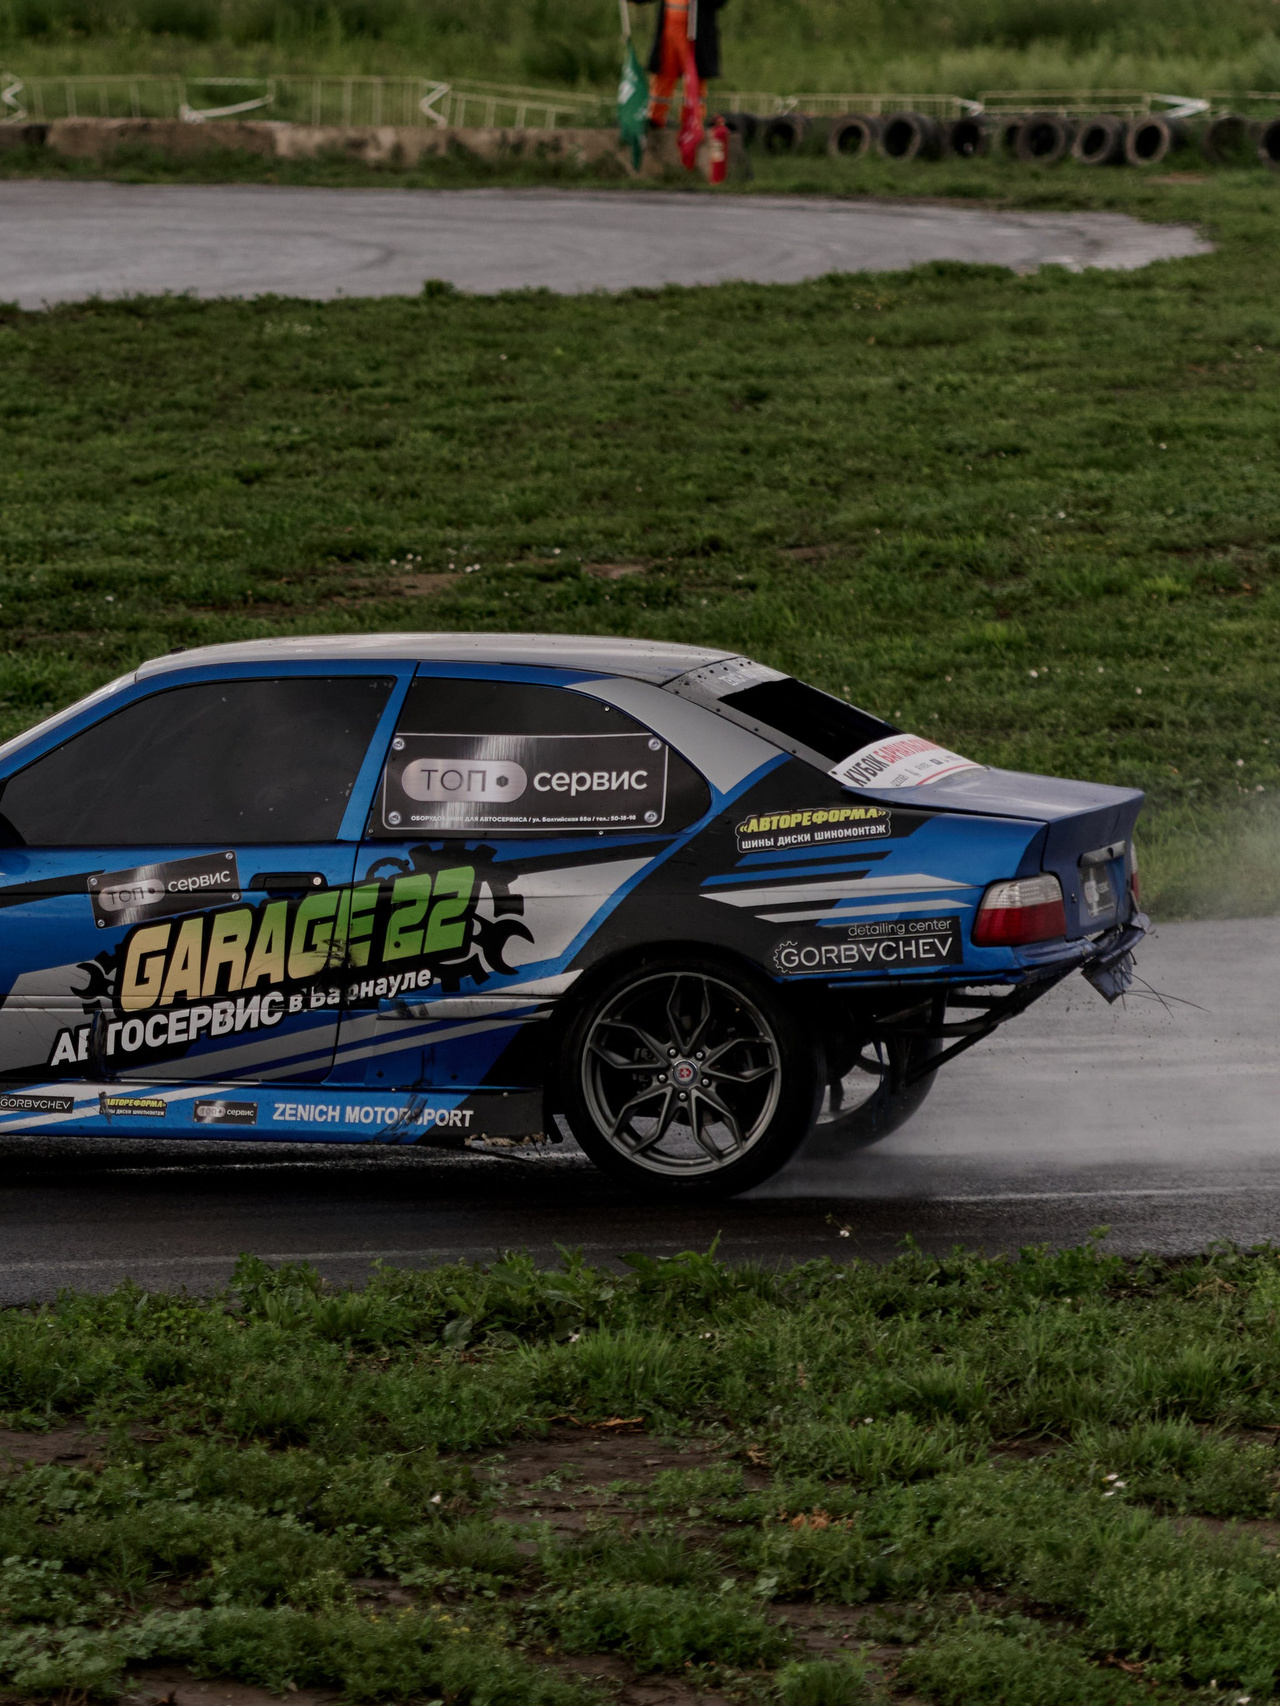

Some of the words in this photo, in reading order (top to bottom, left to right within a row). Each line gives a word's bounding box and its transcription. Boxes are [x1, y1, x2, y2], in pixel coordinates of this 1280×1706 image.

[420, 769, 487, 792] ТОП
[533, 769, 649, 796] сервис
[842, 753, 891, 788] КУБОК
[740, 808, 886, 833] «АВТОРЕФОРМА»
[742, 838, 774, 850] шины
[777, 832, 810, 846] диски
[814, 824, 886, 841] шиномонтаж
[107, 886, 145, 905] ТОП
[168, 870, 231, 893] сервис
[120, 883, 380, 1012] GARAGE
[382, 865, 476, 962] 22
[848, 922, 905, 937] detailing
[908, 919, 952, 933] center
[288, 992, 303, 1013] в
[226, 1109, 255, 1117] сервис
[272, 1103, 339, 1123] ZENICH
